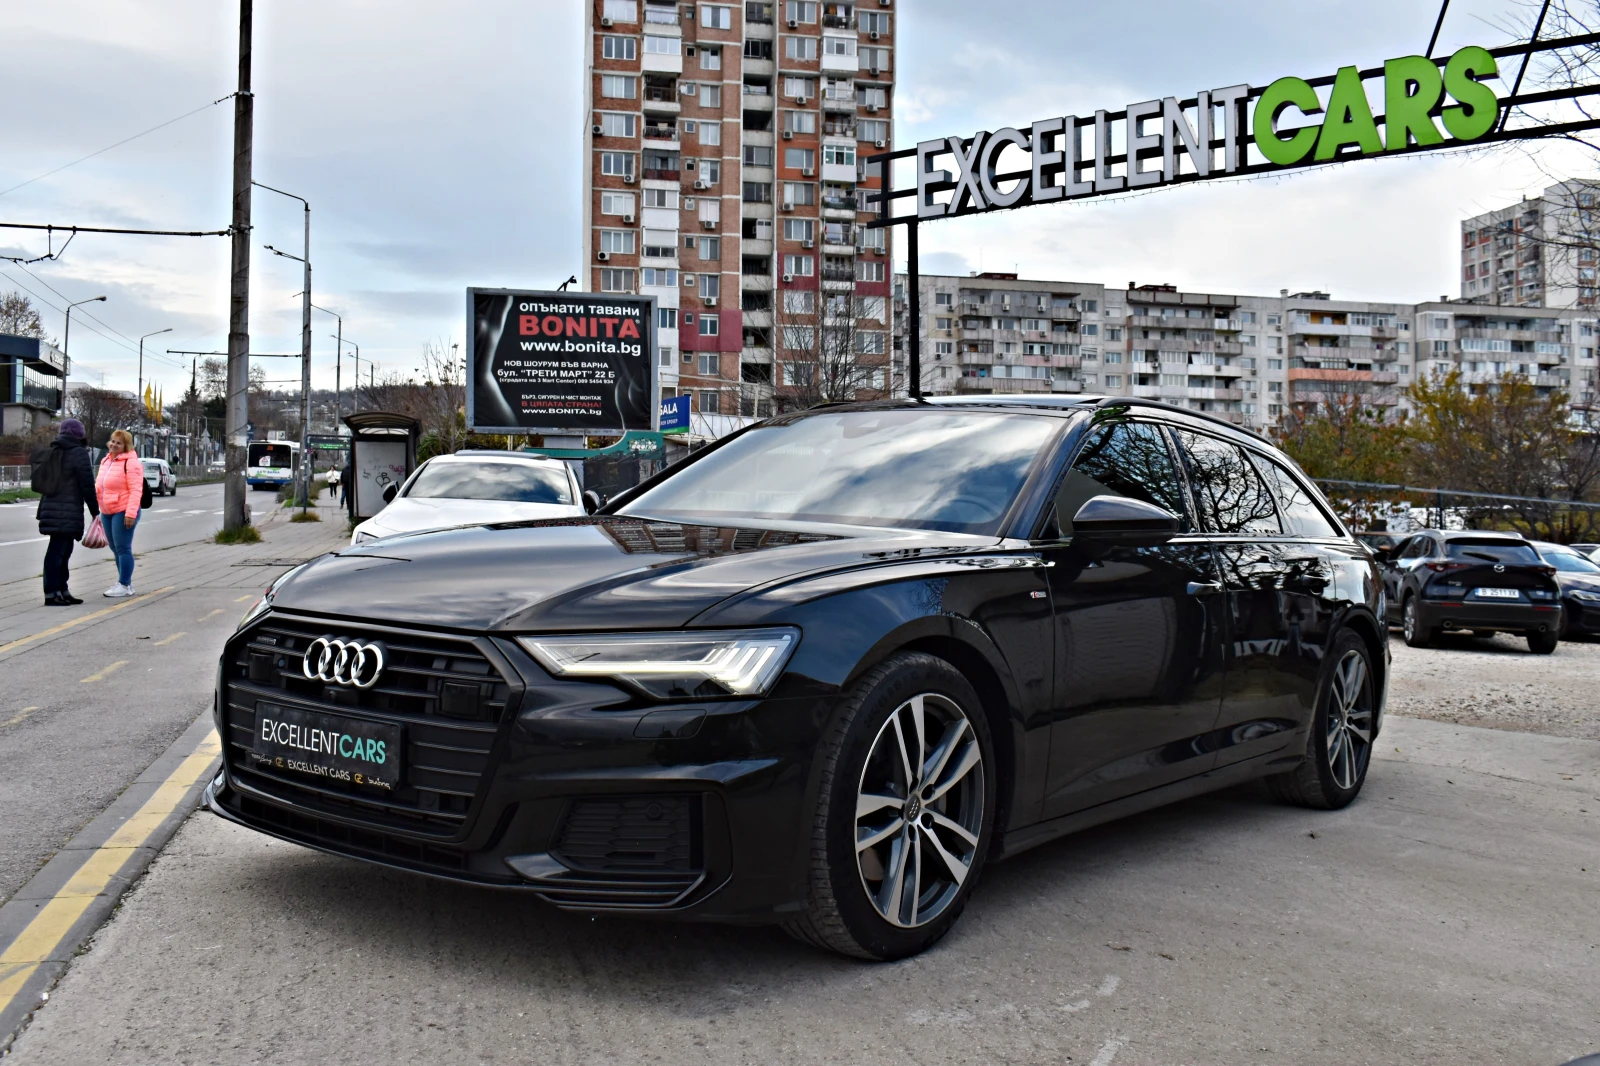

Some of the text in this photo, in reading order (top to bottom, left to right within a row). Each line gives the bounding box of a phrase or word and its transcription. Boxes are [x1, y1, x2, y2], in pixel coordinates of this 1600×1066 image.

[519, 302, 640, 316] опънати тавани
[519, 314, 640, 338] BONITA
[520, 340, 641, 356] www.bonita.bg
[497, 368, 518, 377] бул.
[287, 759, 329, 775] EXCELLENT
[329, 768, 350, 781] CARS
